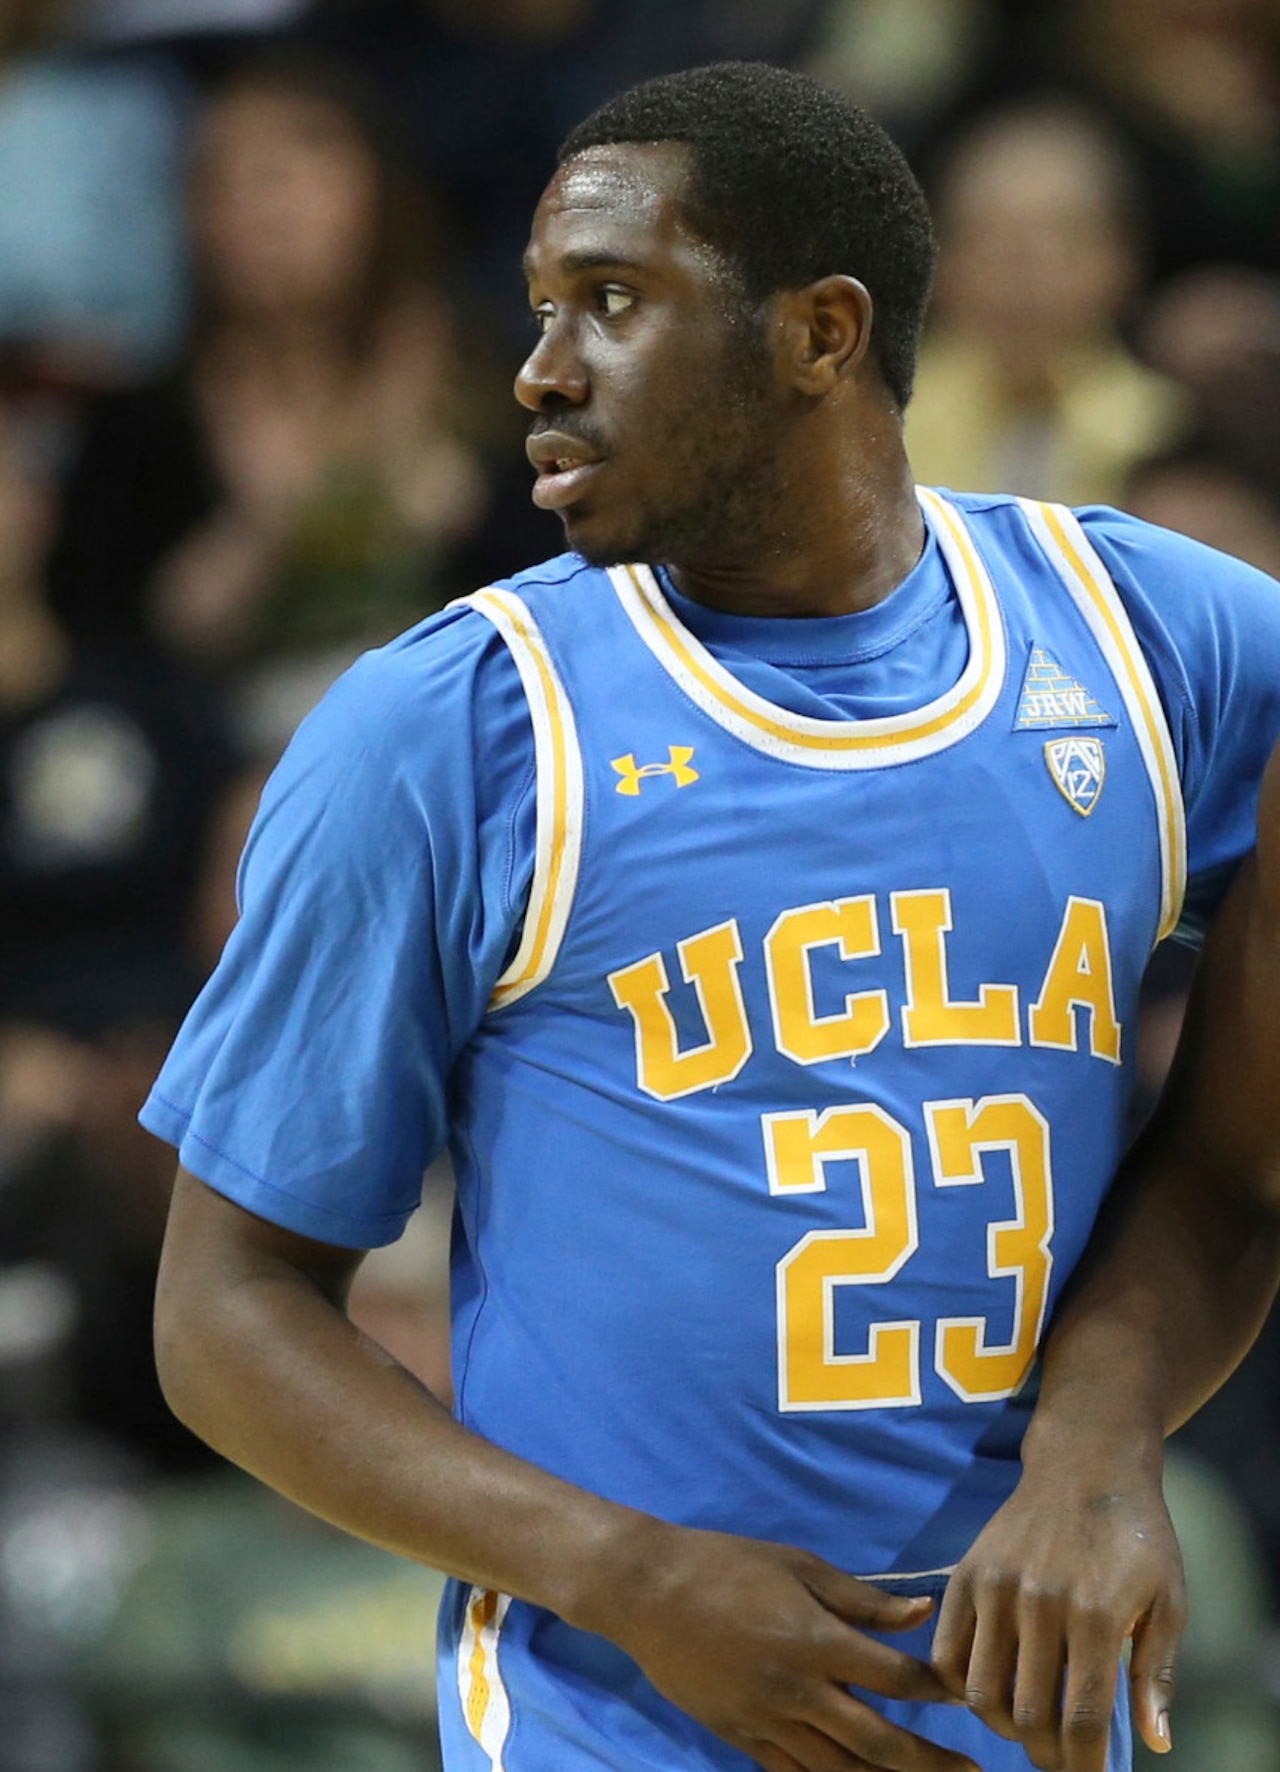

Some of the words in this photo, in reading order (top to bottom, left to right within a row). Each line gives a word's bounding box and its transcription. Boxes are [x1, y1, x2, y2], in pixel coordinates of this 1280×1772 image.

[1026, 692, 1088, 717] JRW
[1050, 740, 1100, 784] PAC
[1067, 769, 1096, 799] 12
[607, 888, 1122, 1102] UCLA
[760, 1093, 1054, 1412] 23
